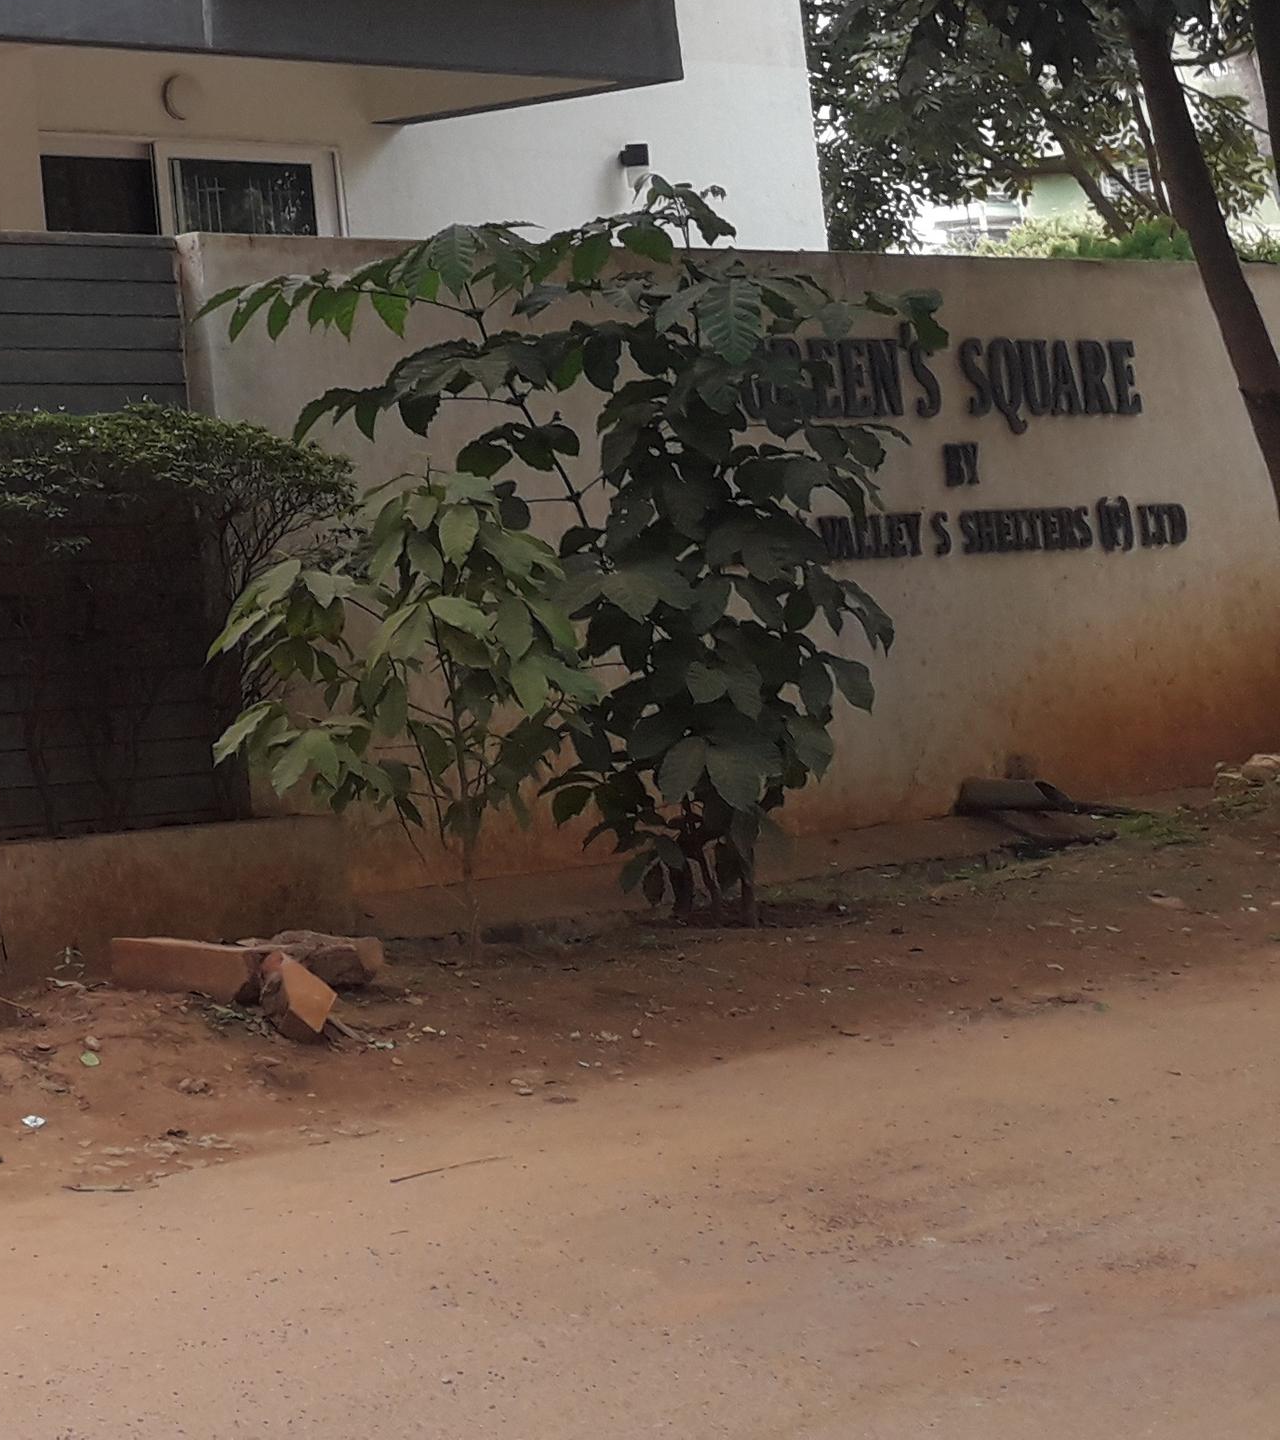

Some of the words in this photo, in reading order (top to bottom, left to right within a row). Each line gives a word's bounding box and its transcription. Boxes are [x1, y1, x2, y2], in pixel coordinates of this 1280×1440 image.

[958, 337, 1143, 435] SQUARE
[943, 442, 980, 488] BY
[959, 506, 1093, 554] SHELTERS
[1096, 495, 1134, 552] (P)
[1136, 502, 1188, 548] LTD
